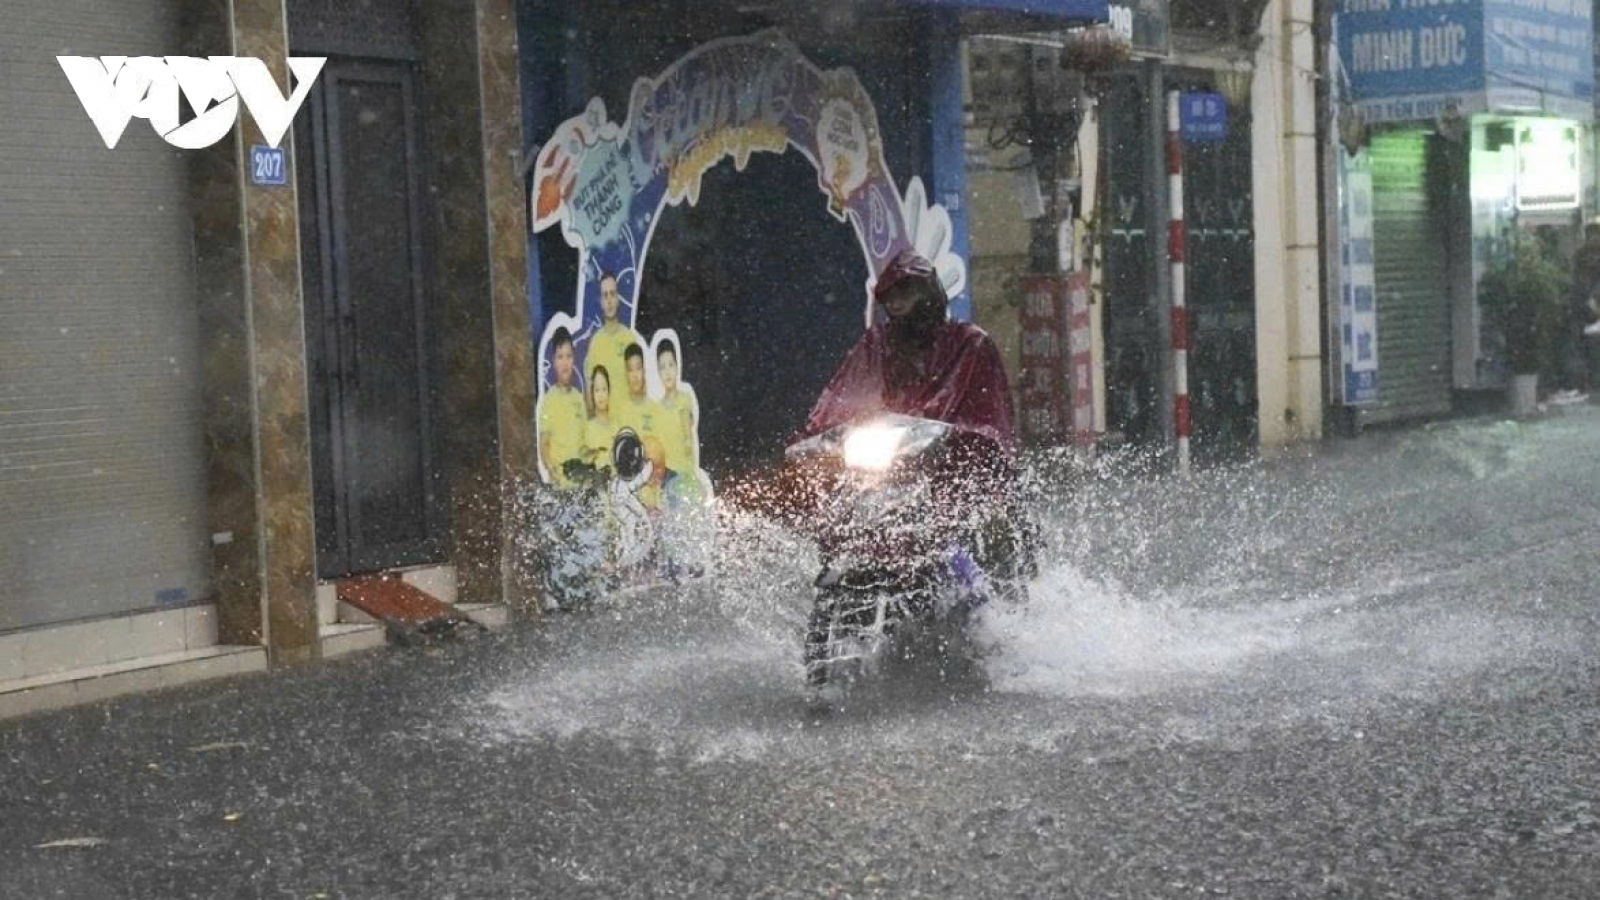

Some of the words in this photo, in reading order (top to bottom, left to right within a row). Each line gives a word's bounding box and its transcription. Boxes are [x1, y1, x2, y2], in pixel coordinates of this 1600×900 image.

[1351, 29, 1412, 72] MINH
[1420, 14, 1466, 68] ĐỨC
[255, 152, 281, 177] 207
